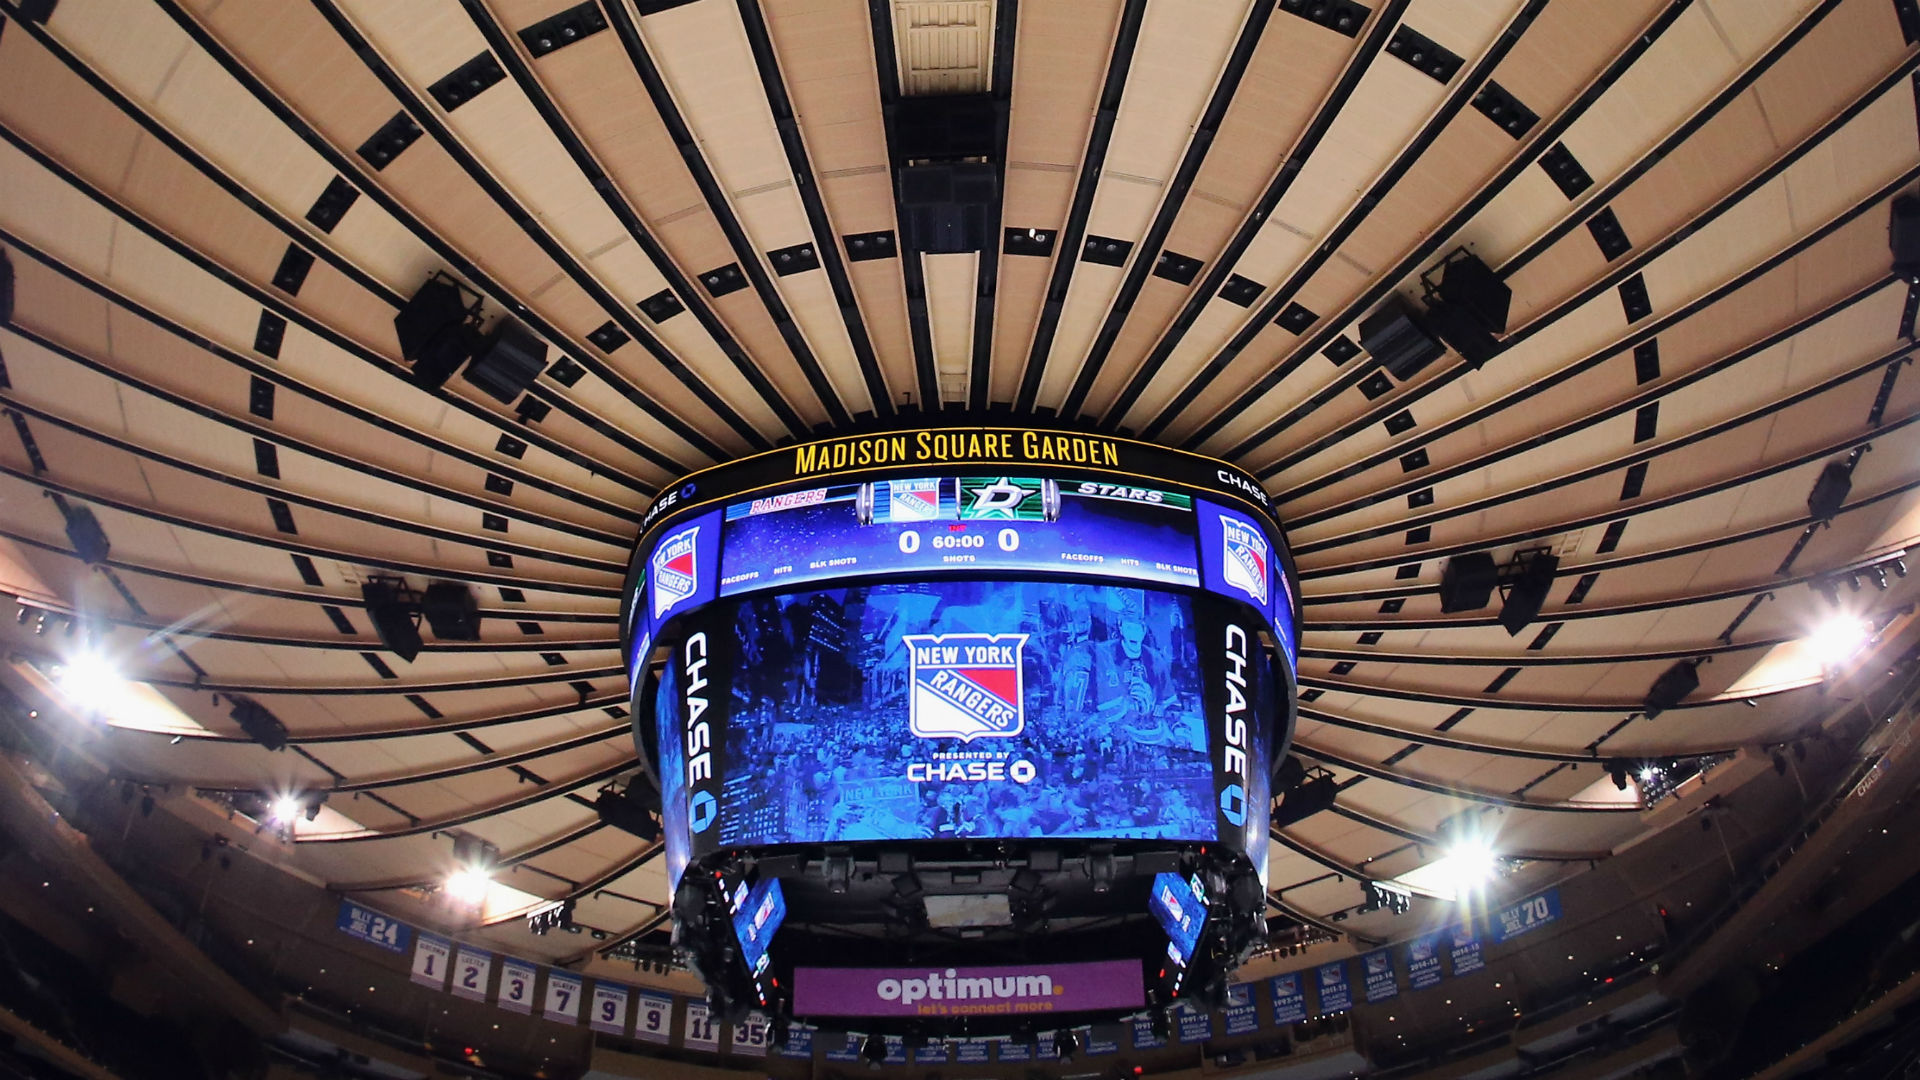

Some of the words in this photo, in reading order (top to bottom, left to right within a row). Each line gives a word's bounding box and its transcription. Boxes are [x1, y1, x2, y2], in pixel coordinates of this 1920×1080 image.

[795, 437, 906, 475] MADISON
[916, 432, 1014, 460] SQUARE
[1022, 431, 1119, 466] GARDEN
[893, 482, 912, 491] NEW
[913, 481, 935, 490] YORK
[1078, 482, 1165, 503] STARS
[1217, 470, 1268, 506] CHASE
[749, 488, 828, 515] RANGERS
[899, 530, 920, 553] 0
[932, 535, 984, 549] 60:00
[998, 528, 1020, 551] 0
[1227, 525, 1250, 545] NEW
[667, 539, 691, 559] YORK
[1061, 553, 1104, 563] FACEOFFS
[774, 566, 792, 575] HITS
[810, 561, 827, 569] BLK
[829, 557, 857, 566] SHOTS
[1121, 558, 1139, 566] HITS
[1156, 563, 1171, 571] BLK
[1173, 565, 1197, 575] SHOTS
[721, 571, 759, 585] FACEOFFS
[917, 646, 958, 664] NEW
[965, 646, 1015, 663] YORK
[930, 670, 1014, 728] RANGERS
[1225, 624, 1247, 780] CHASE
[685, 632, 712, 788] CHASE
[932, 752, 992, 760] PRESENTED
[996, 752, 1010, 760] BY
[907, 762, 1005, 782] CHASE
[1522, 897, 1548, 924] 70
[371, 917, 398, 945] 24
[424, 954, 435, 976] 1
[463, 966, 478, 988] 2
[509, 979, 524, 1000] 3
[556, 990, 570, 1012] 7
[601, 1001, 616, 1022] 9
[918, 1004, 948, 1015] let's
[951, 1002, 1011, 1014] connect
[1015, 1000, 1053, 1012] more
[646, 1010, 661, 1031] 9
[692, 1018, 712, 1040] 11
[736, 1022, 764, 1045] 35
